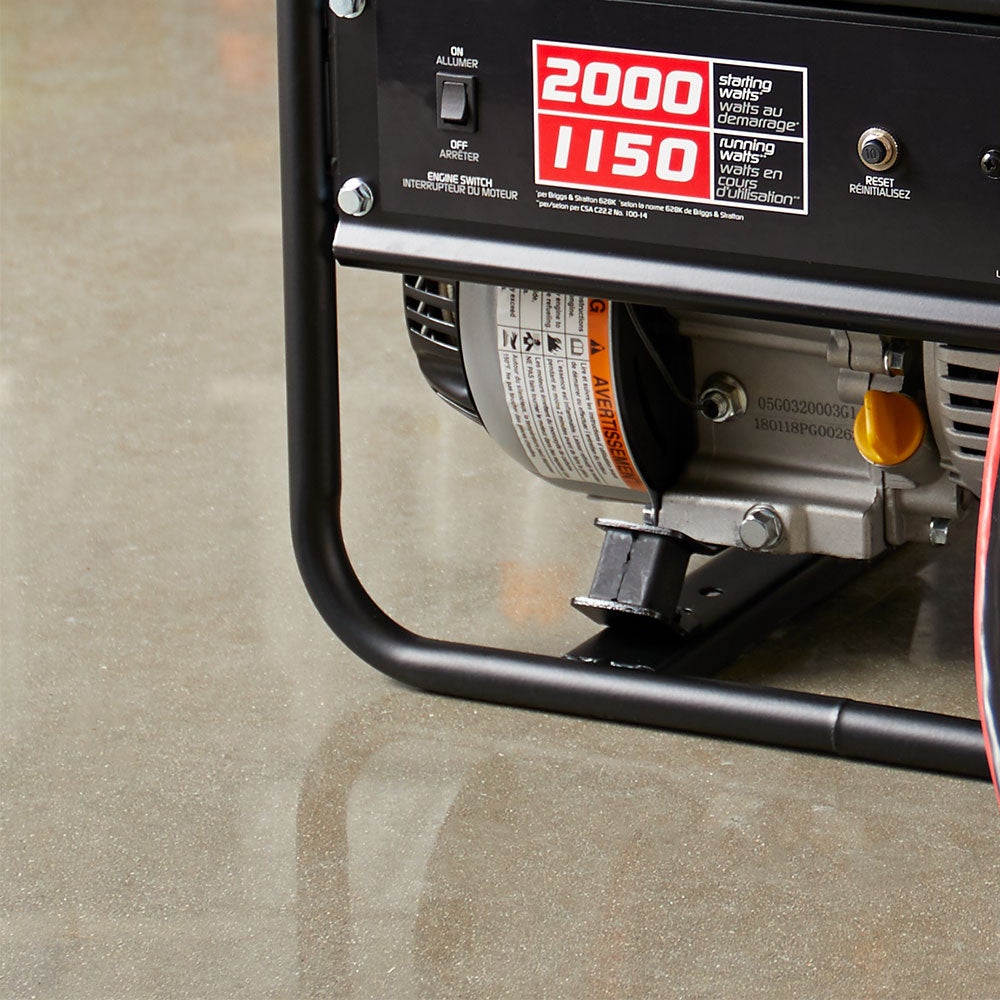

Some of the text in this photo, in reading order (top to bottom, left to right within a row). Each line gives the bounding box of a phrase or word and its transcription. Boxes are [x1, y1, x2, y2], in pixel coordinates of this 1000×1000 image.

[450, 45, 464, 57] ON
[436, 55, 479, 69] ALLUMER
[541, 56, 703, 116] 2000
[718, 73, 772, 93] starting
[719, 101, 783, 117] watts au
[450, 139, 468, 150] OFF
[719, 137, 775, 156] running
[439, 148, 480, 162] ARRÊTER
[553, 125, 698, 183] 1150
[427, 171, 493, 188] ENGINE SWITCH
[719, 163, 783, 180] watts en
[402, 178, 518, 200] INTERRUPTEUR DU MOTEUR
[718, 176, 758, 190] cours
[865, 175, 895, 188] RESET
[849, 182, 911, 200] RÉINITIALISEZ
[580, 205, 593, 213] CSA
[625, 210, 648, 219] 100-14
[754, 417, 855, 441] 180118PG0026
